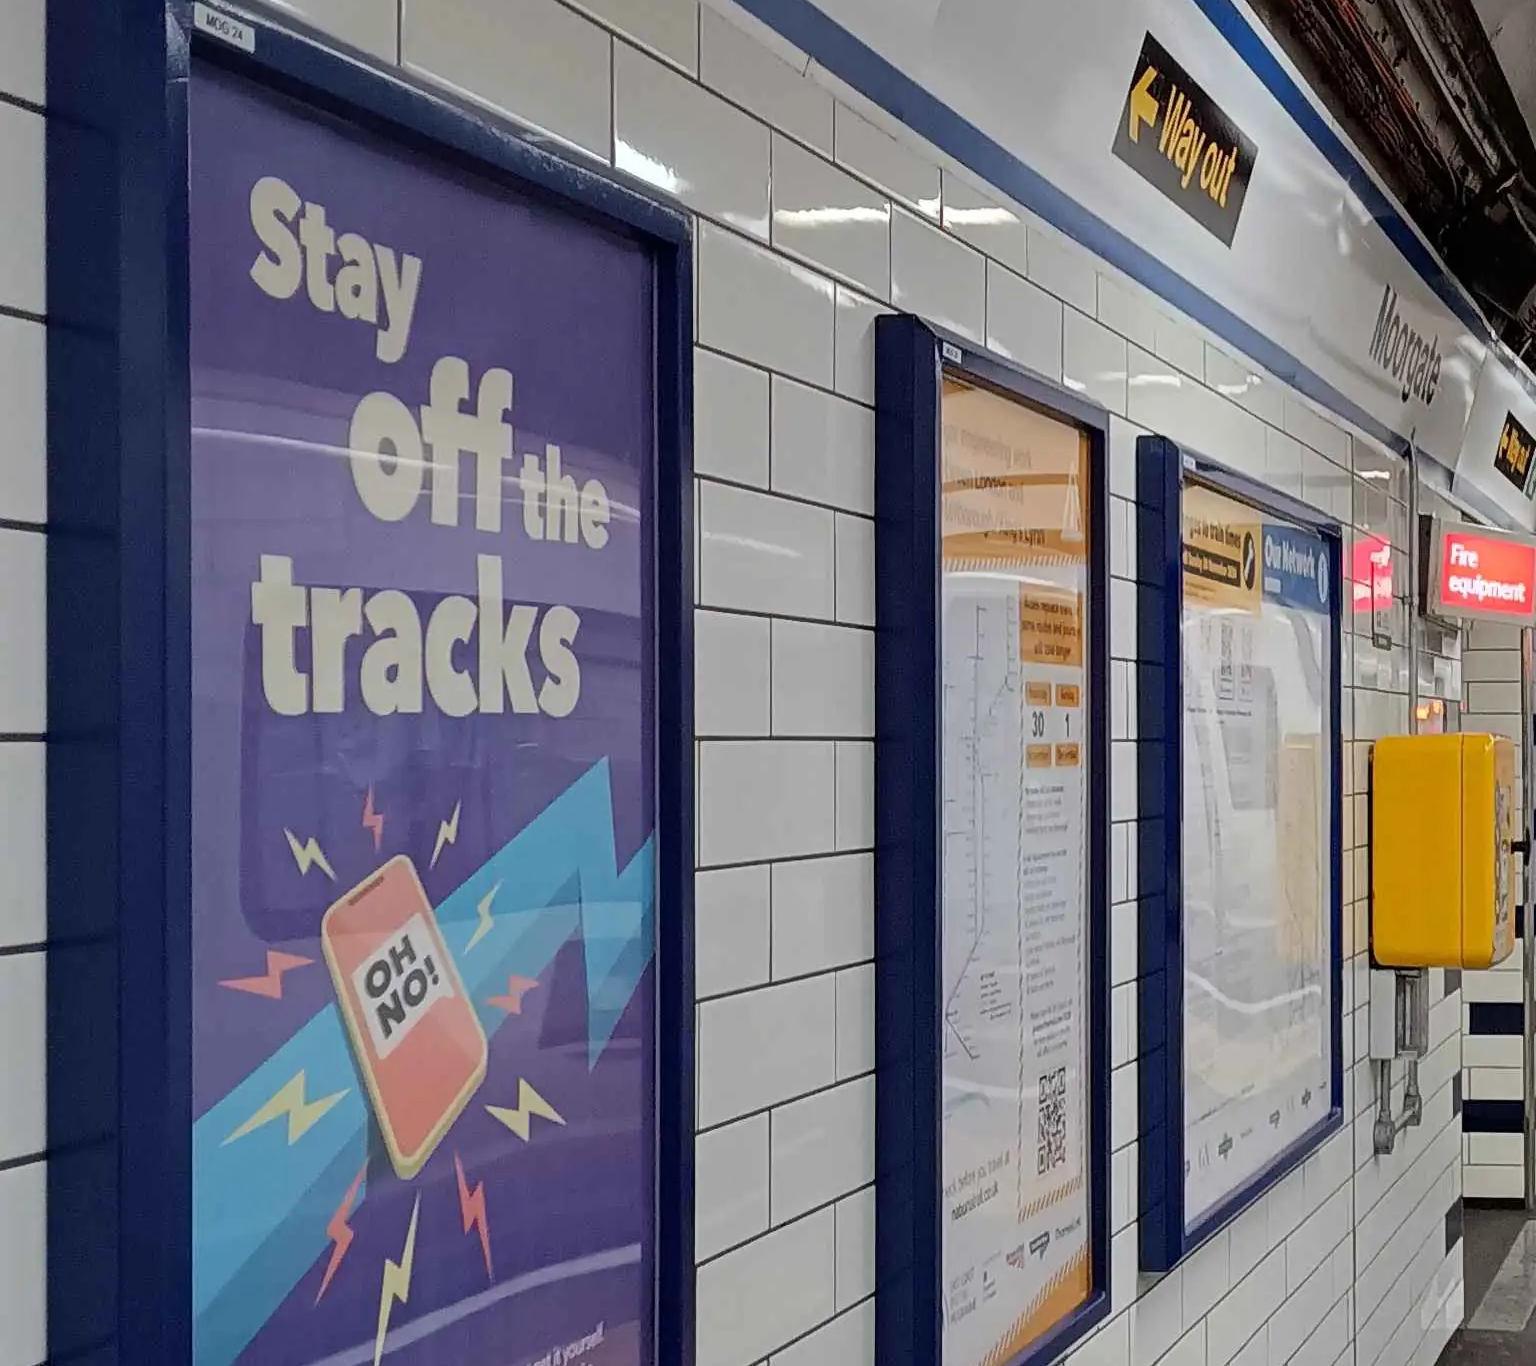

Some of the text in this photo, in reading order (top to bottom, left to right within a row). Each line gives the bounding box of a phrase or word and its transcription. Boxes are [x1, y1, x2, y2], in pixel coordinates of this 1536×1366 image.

[1159, 83, 1238, 209] Way out
[249, 176, 424, 365] Stay
[1369, 283, 1443, 406] Moorgate
[349, 354, 610, 550] off the
[1264, 534, 1281, 569] Our
[1282, 539, 1316, 580] Network
[1449, 575, 1526, 604] equipment
[1450, 542, 1479, 568] Fire
[251, 553, 582, 719] tracks
[1032, 711, 1070, 738] 30 1
[364, 933, 418, 1000] OH
[375, 955, 440, 1040] NO!
[552, 1346, 562, 1366] it
